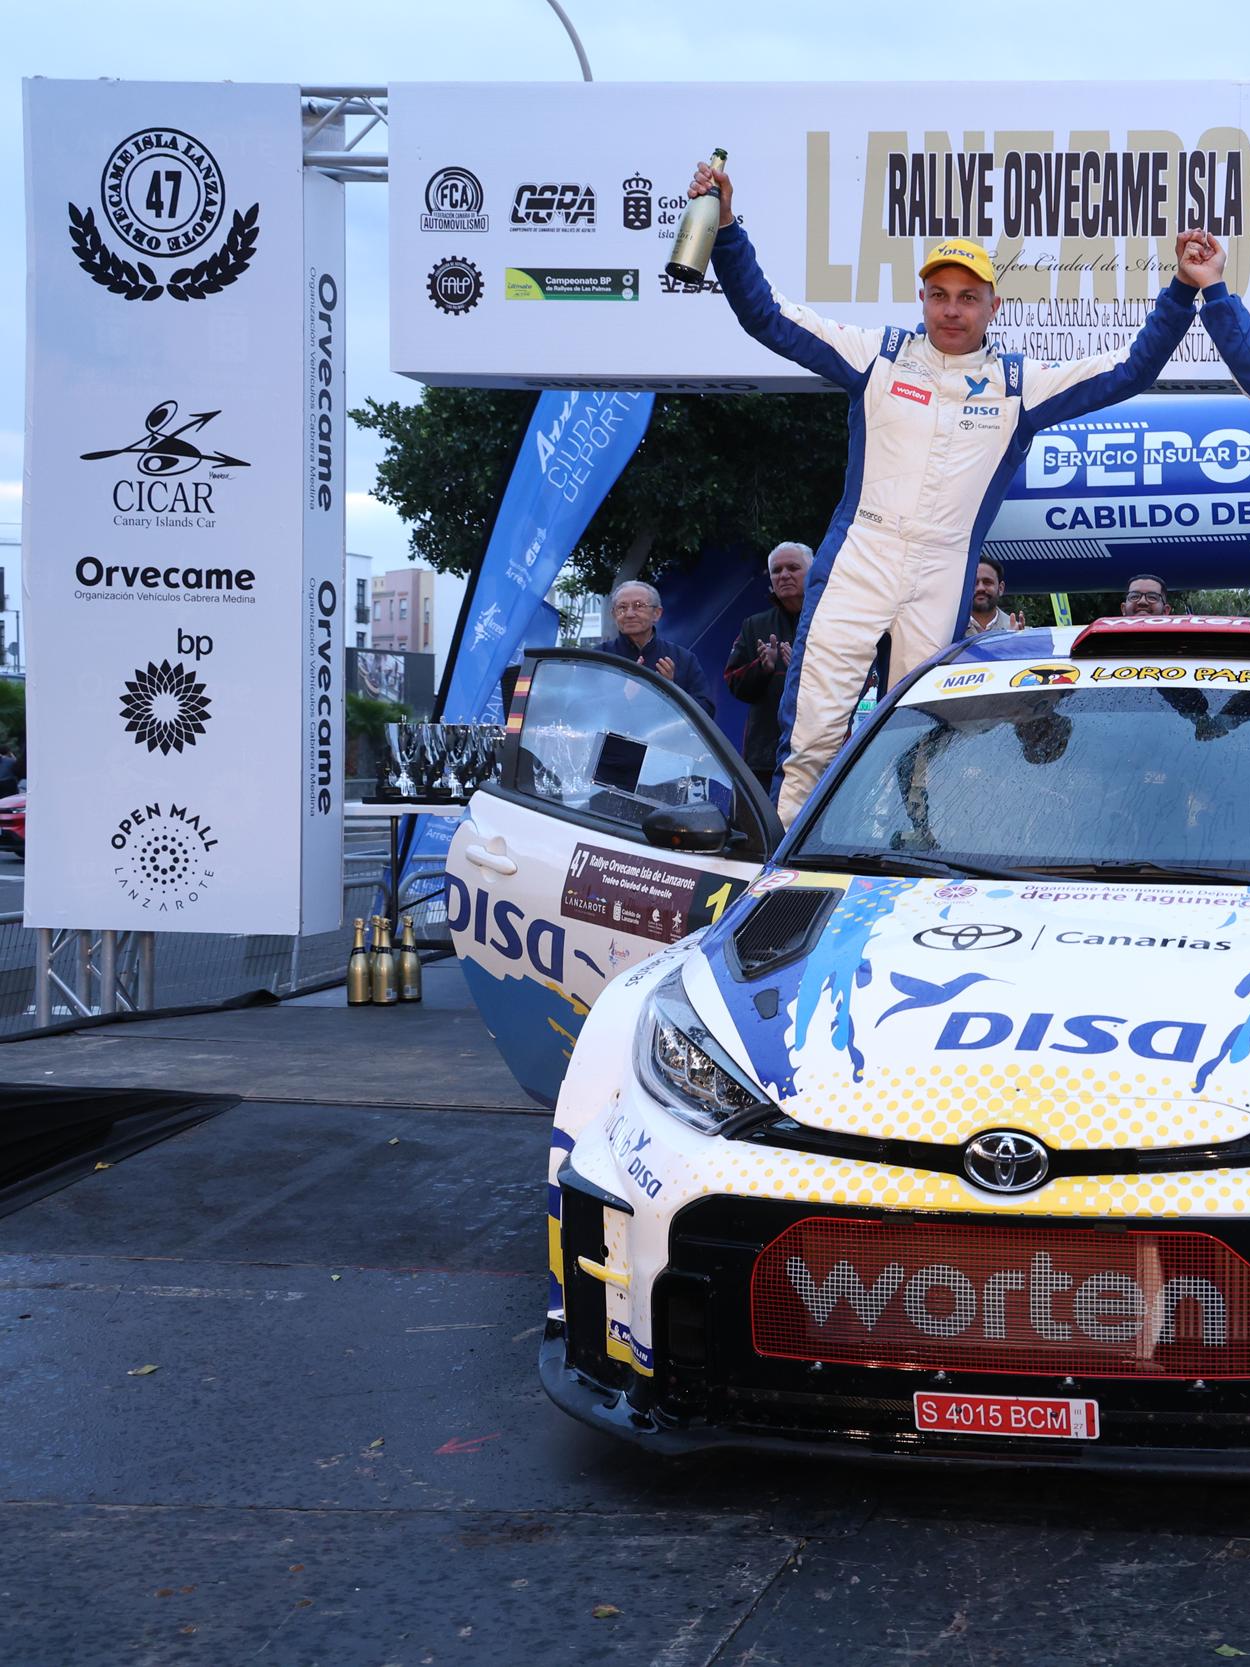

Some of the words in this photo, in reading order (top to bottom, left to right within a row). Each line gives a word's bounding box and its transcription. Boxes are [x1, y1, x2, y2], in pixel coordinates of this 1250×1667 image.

[131, 132, 179, 156] ISLA
[145, 170, 183, 219] 47
[440, 183, 469, 209] FCA
[889, 151, 993, 238] RALLYE
[1003, 149, 1168, 238] ORVECAME
[1178, 149, 1244, 237] ISLA
[423, 217, 486, 230] AUTOMOVILISMO
[1034, 253, 1101, 272] Ciudad
[1101, 253, 1120, 272] de
[545, 277, 599, 287] Campeonato
[600, 277, 612, 286] BP
[1026, 305, 1035, 327] de
[1037, 297, 1099, 327] CANARIAS
[1102, 305, 1110, 327] de
[1022, 331, 1074, 361] ASFALTO
[317, 272, 338, 512] Orvecame
[896, 386, 926, 401] worten
[962, 406, 999, 416] DISA
[1045, 449, 1138, 467] SERVICIO
[1143, 447, 1231, 465] INSULAR
[112, 480, 216, 515] CICAR
[113, 515, 152, 530] Canary
[156, 516, 194, 529] Islands
[196, 517, 216, 528] Car
[859, 509, 883, 524] sparco
[1045, 502, 1200, 531] CABILDO
[75, 556, 256, 591] Orvecame
[74, 590, 134, 602] Organización
[137, 592, 181, 602] Vehículos
[183, 593, 220, 603] Cabrera
[222, 594, 256, 604] Medina
[177, 628, 214, 661] bp
[942, 673, 986, 689] NAPA
[1090, 665, 1186, 682] LORO
[317, 580, 337, 816] Orvecame
[111, 802, 162, 850] OPEN
[169, 803, 219, 852] MALL
[571, 850, 590, 879] 47
[589, 854, 610, 872] Rallye
[609, 861, 641, 878] Orvecame
[651, 868, 662, 882] de
[661, 869, 695, 891] Lanzarote
[113, 866, 214, 912] LANZAROTE
[705, 882, 733, 924] 1
[1020, 889, 1127, 903] deporte
[564, 896, 606, 915] LANZAROTE
[446, 870, 566, 985] DISA
[1055, 931, 1232, 953] Canarias
[934, 1012, 1207, 1064] DISA
[786, 1251, 1227, 1347] worten
[922, 1400, 938, 1423] S
[945, 1403, 1003, 1427] 4015
[1010, 1406, 1068, 1430] BCM
